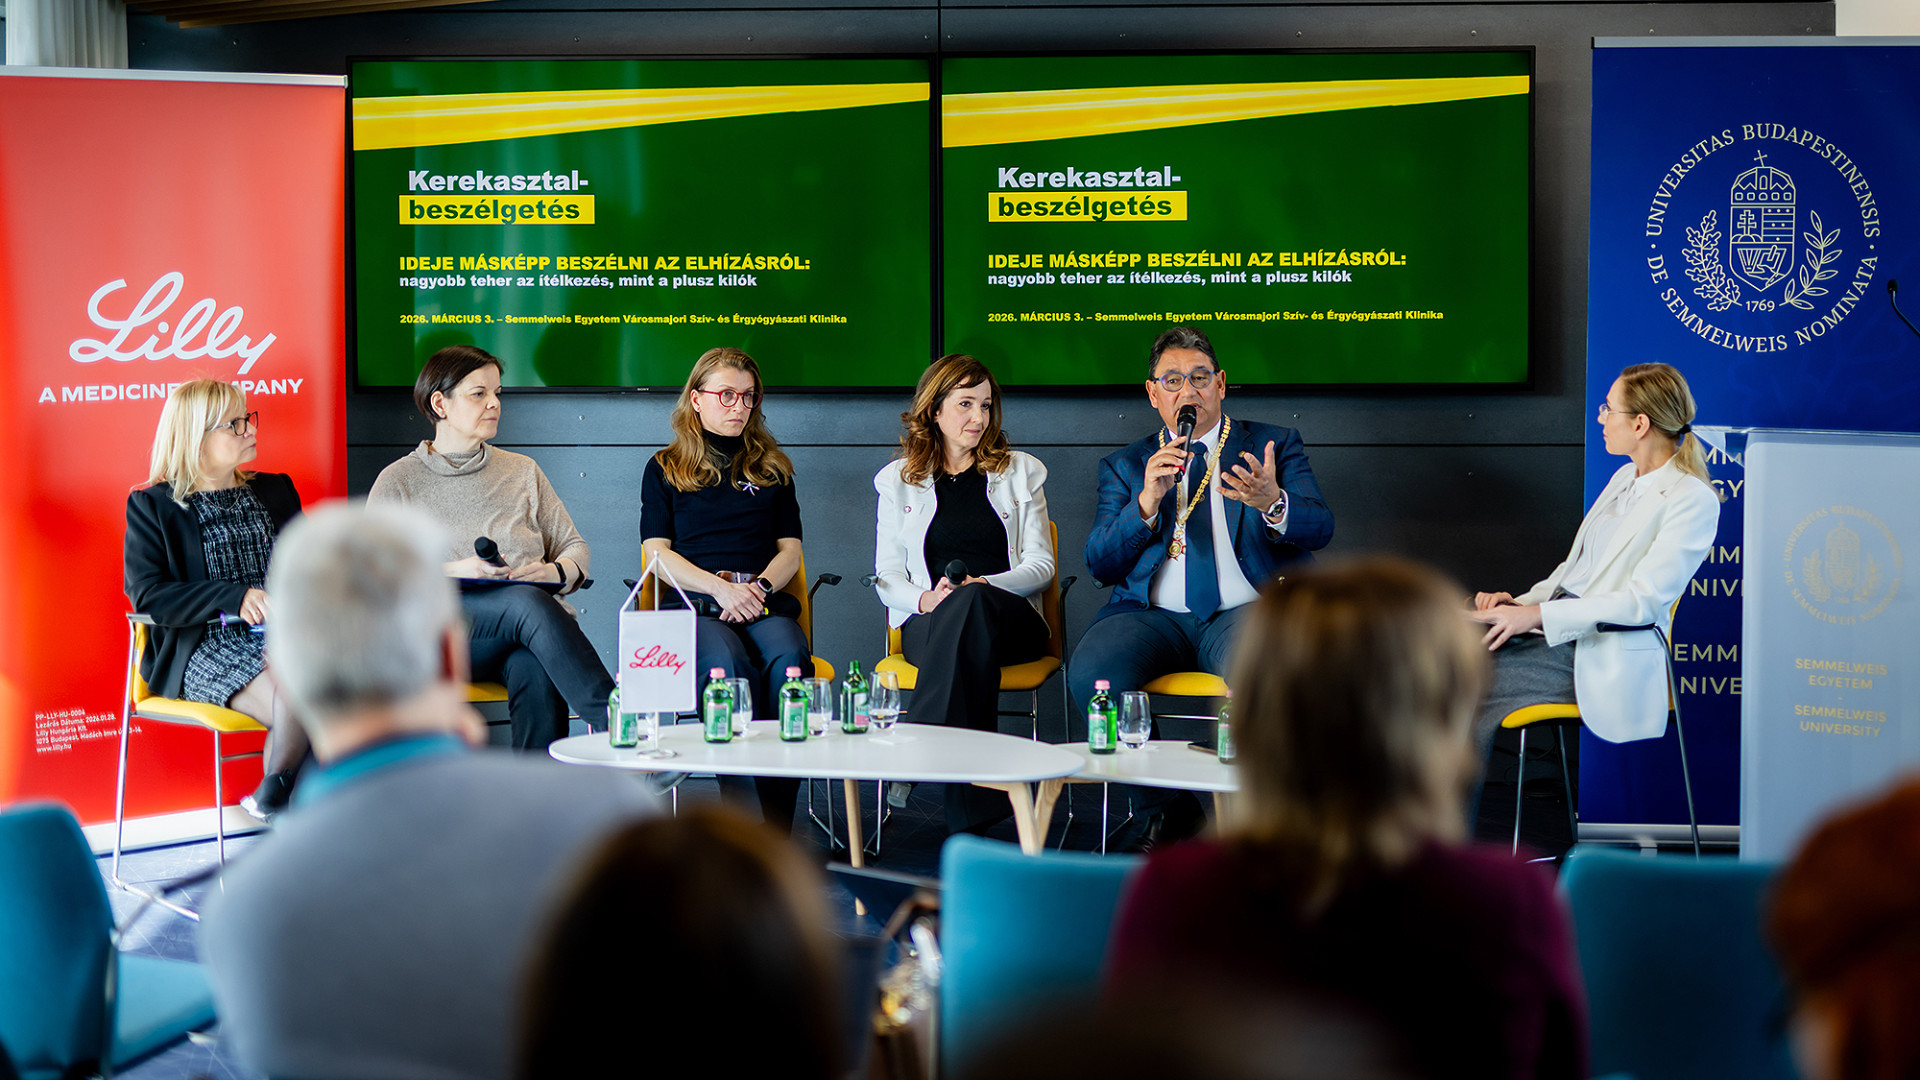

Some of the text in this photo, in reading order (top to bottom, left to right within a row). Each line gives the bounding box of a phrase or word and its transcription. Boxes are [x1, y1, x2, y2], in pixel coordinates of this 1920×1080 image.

[408, 169, 589, 191] Kerekasztal-
[998, 166, 1182, 188] Kerekasztal-
[1646, 123, 1881, 238] UNIVERSITAS BUDAPESTINENSIS
[409, 199, 580, 225] beszélgetés
[998, 195, 1172, 222] beszélgetés
[400, 253, 811, 271] IDEJE MÁSKÉPP BESZÉLNI AZ ELHÍZÁSRÓL:
[988, 248, 1407, 268] IDEJE MÁSKÉPP BESZÉLNI AZ ELHÍZÁSRÓL:
[400, 274, 758, 290] nagyobb teher az ítélkezés, mint a plusz kilók
[988, 270, 1352, 287] nagyobb teher az ítélkezés, mint a plusz kilók
[1646, 254, 1879, 353] DE SEMMELWEIS NOMINATA
[1745, 299, 1775, 312] 1769
[69, 271, 277, 375] Lilly
[400, 314, 429, 324] 2026.
[431, 313, 482, 324] MÁRCIUS
[485, 315, 495, 324] 3.
[505, 314, 572, 324] Semmelweis
[574, 315, 620, 326] Egyetem
[623, 313, 687, 325] Városmajori
[689, 313, 715, 324] Szív-
[717, 314, 730, 324] és
[733, 312, 807, 326] Érgyógyászati
[810, 314, 847, 324] Klinika
[988, 313, 1017, 322] 2026.
[1020, 311, 1071, 322] MÁRCIUS
[1074, 312, 1084, 322] 3.
[1095, 312, 1163, 322] Semmelweis
[1165, 312, 1212, 323] Egyetem
[1215, 311, 1280, 322] Városmajori
[1283, 311, 1309, 321] Szív-
[1311, 311, 1324, 321] és
[1327, 309, 1402, 322] Érgyógyászati
[1405, 311, 1444, 320] Klinika
[38, 387, 56, 402] A
[629, 645, 686, 675] Lilly
[1795, 658, 1888, 676] SEMMELWEIS
[1808, 674, 1873, 690] EGYETEM
[1794, 704, 1887, 723] SEMMELWEIS
[1800, 721, 1881, 738] UNIVERSITY
